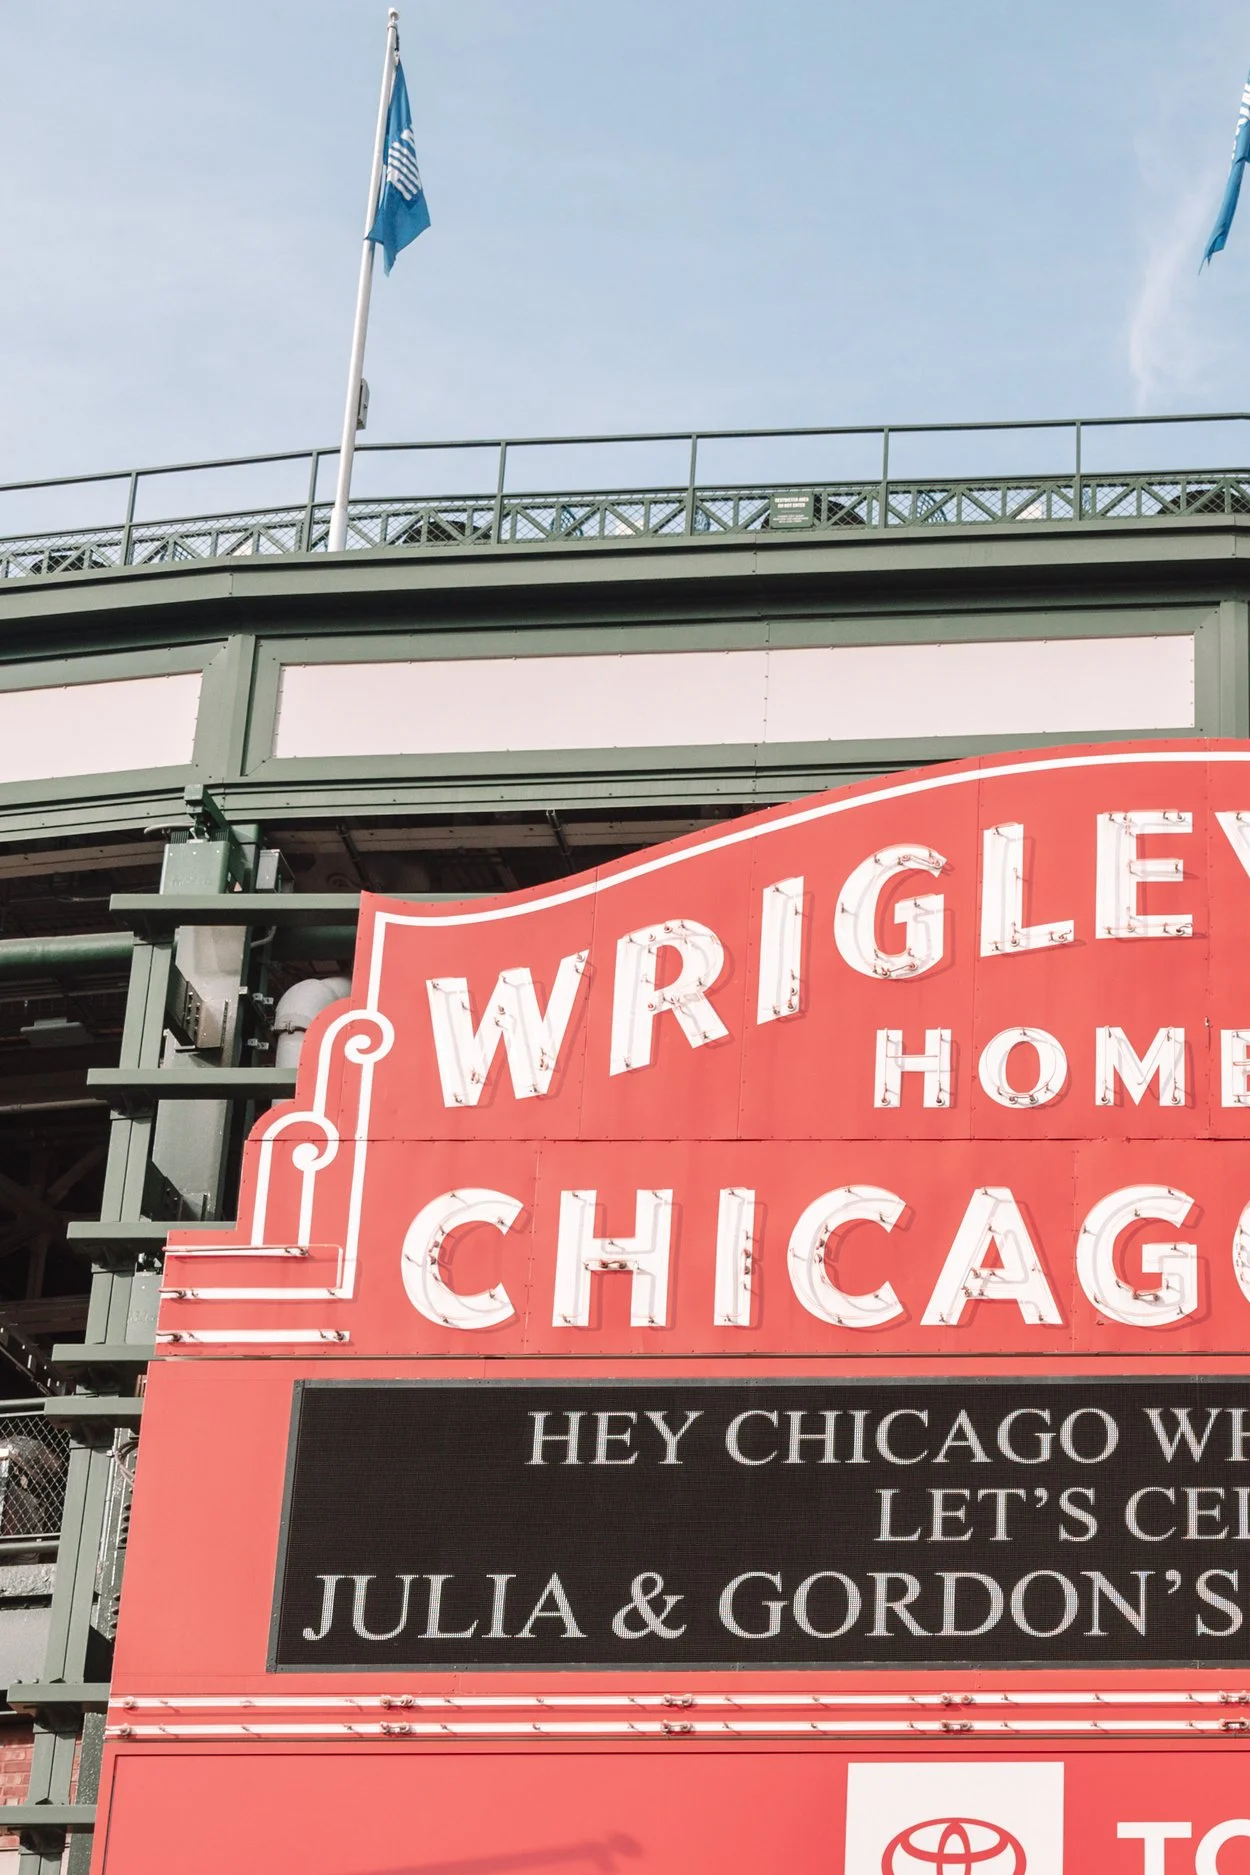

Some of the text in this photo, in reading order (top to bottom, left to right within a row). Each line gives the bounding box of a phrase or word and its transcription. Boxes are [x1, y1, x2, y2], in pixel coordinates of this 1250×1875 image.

[524, 1409, 705, 1467] HEY
[724, 1407, 1121, 1467] CHICAGO
[873, 1486, 1100, 1542] LET'S
[302, 1573, 588, 1642] JULIA
[611, 1570, 688, 1640] &
[717, 1568, 1243, 1640] GORDON'S
